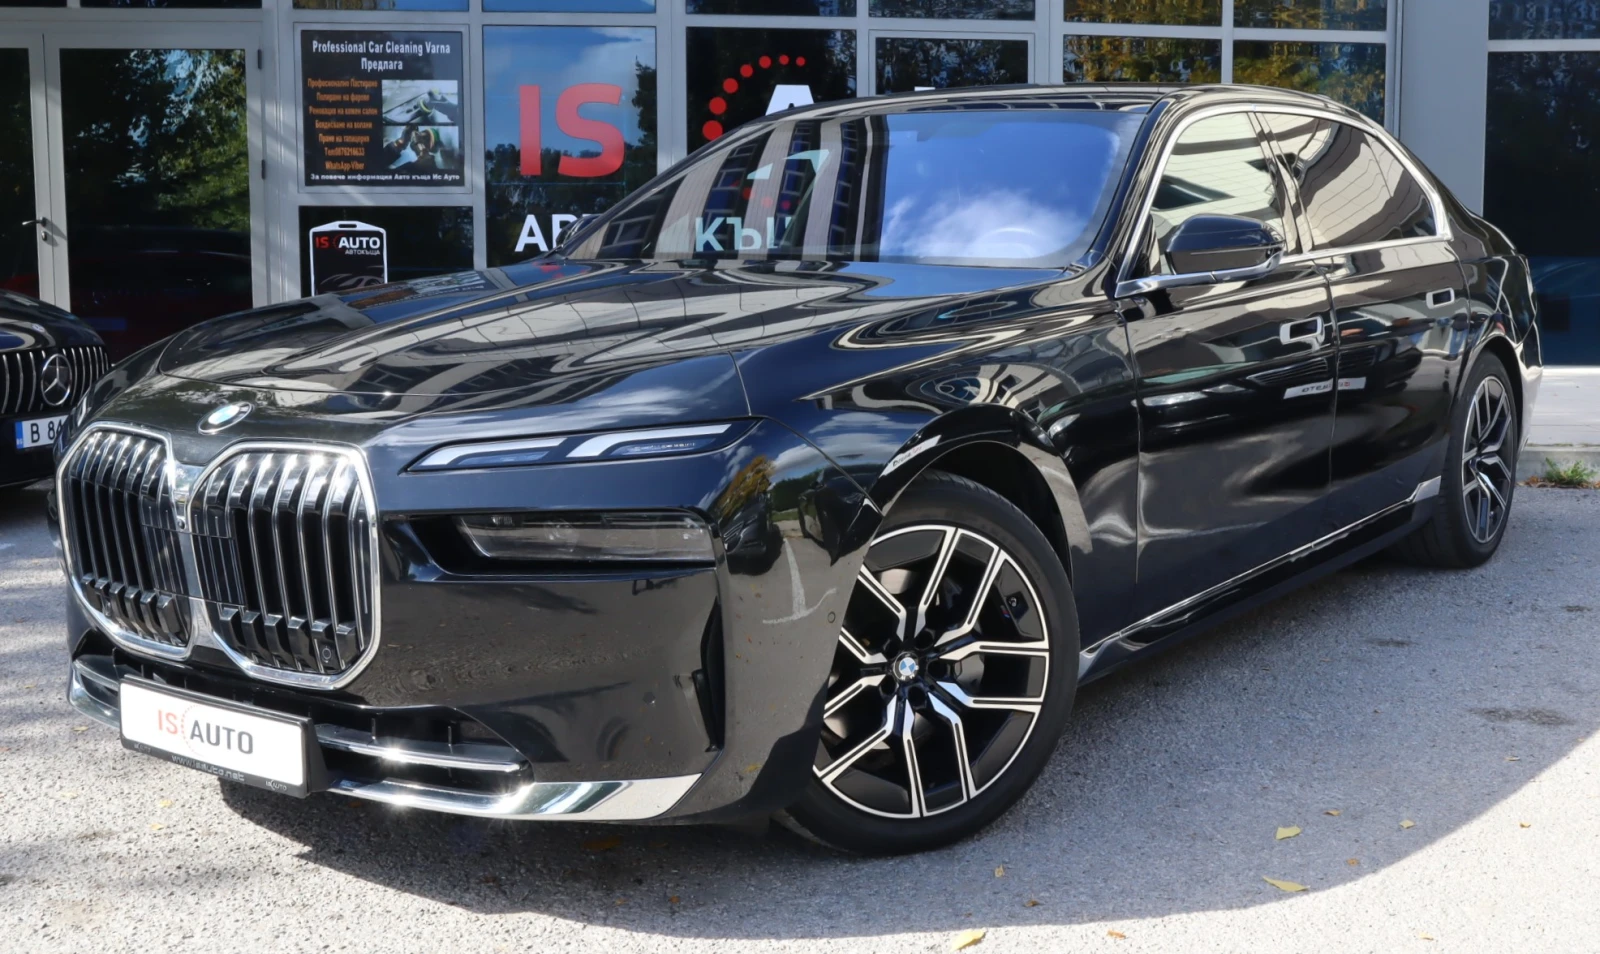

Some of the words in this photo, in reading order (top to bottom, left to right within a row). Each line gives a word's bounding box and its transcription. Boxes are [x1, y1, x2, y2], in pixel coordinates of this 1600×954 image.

[312, 40, 366, 53] Professional
[368, 41, 383, 53] Car
[385, 41, 423, 56] Cleaning
[425, 41, 451, 54] Varna
[361, 57, 403, 72] Предлага
[518, 82, 626, 178] IS
[315, 236, 329, 248] IS
[338, 236, 381, 249] AUTO
[30, 422, 40, 443] B
[157, 709, 178, 735] IS
[190, 719, 254, 755] AUTO
